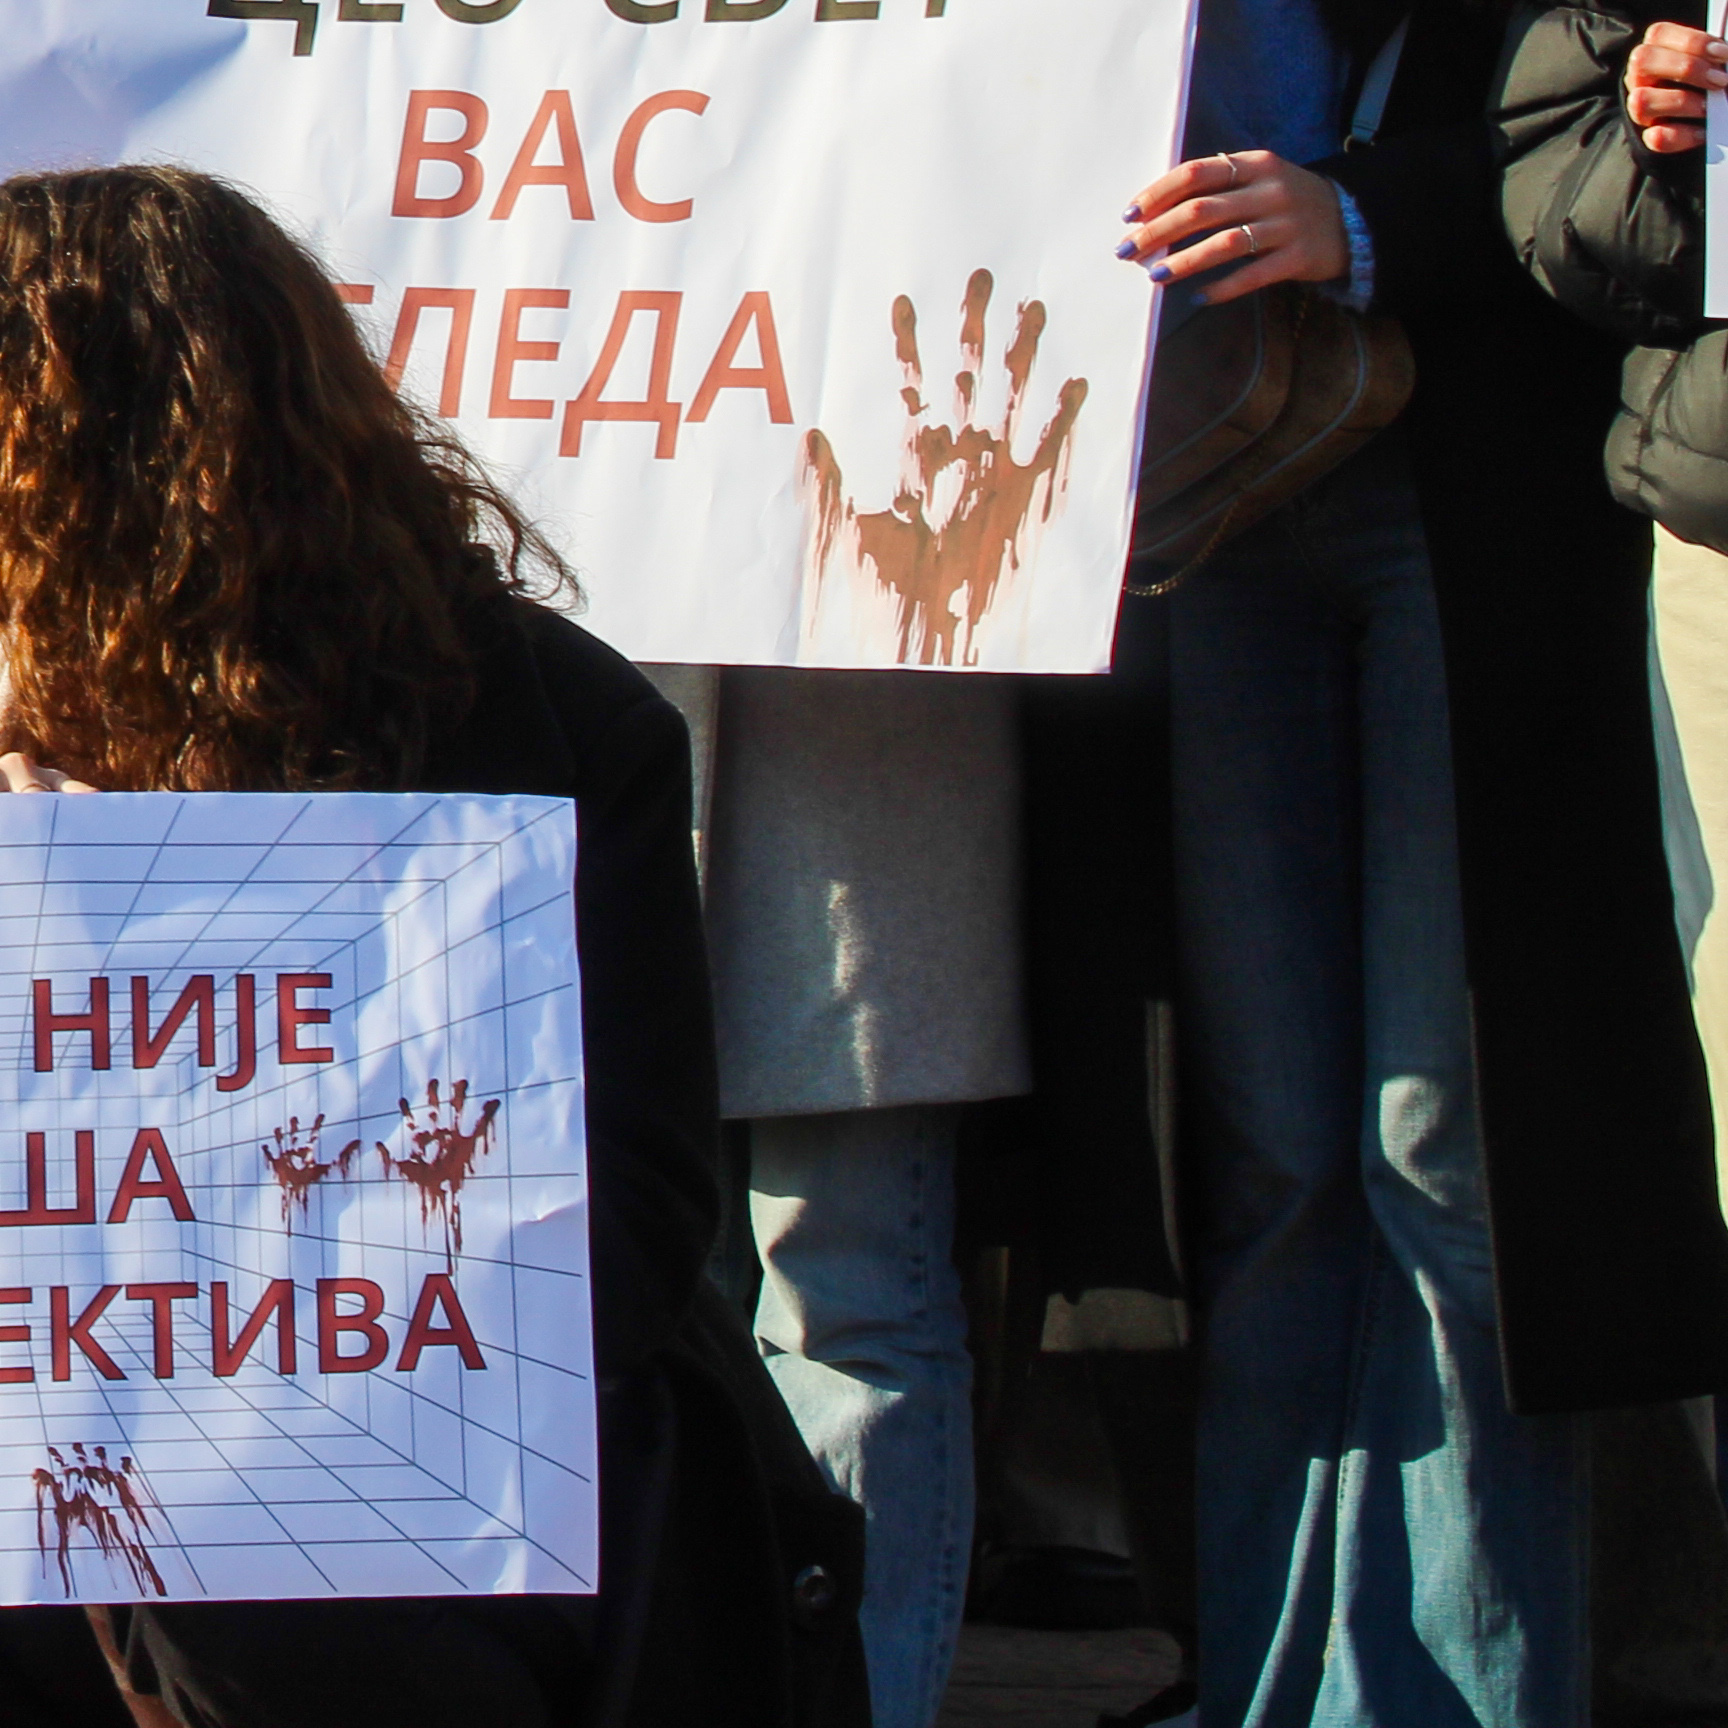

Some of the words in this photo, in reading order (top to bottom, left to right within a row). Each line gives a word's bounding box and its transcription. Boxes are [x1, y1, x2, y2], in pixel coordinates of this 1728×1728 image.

[388, 87, 713, 225] ВАС
[334, 283, 794, 460] ЛЕДА
[31, 971, 336, 1095] НИЈЕ
